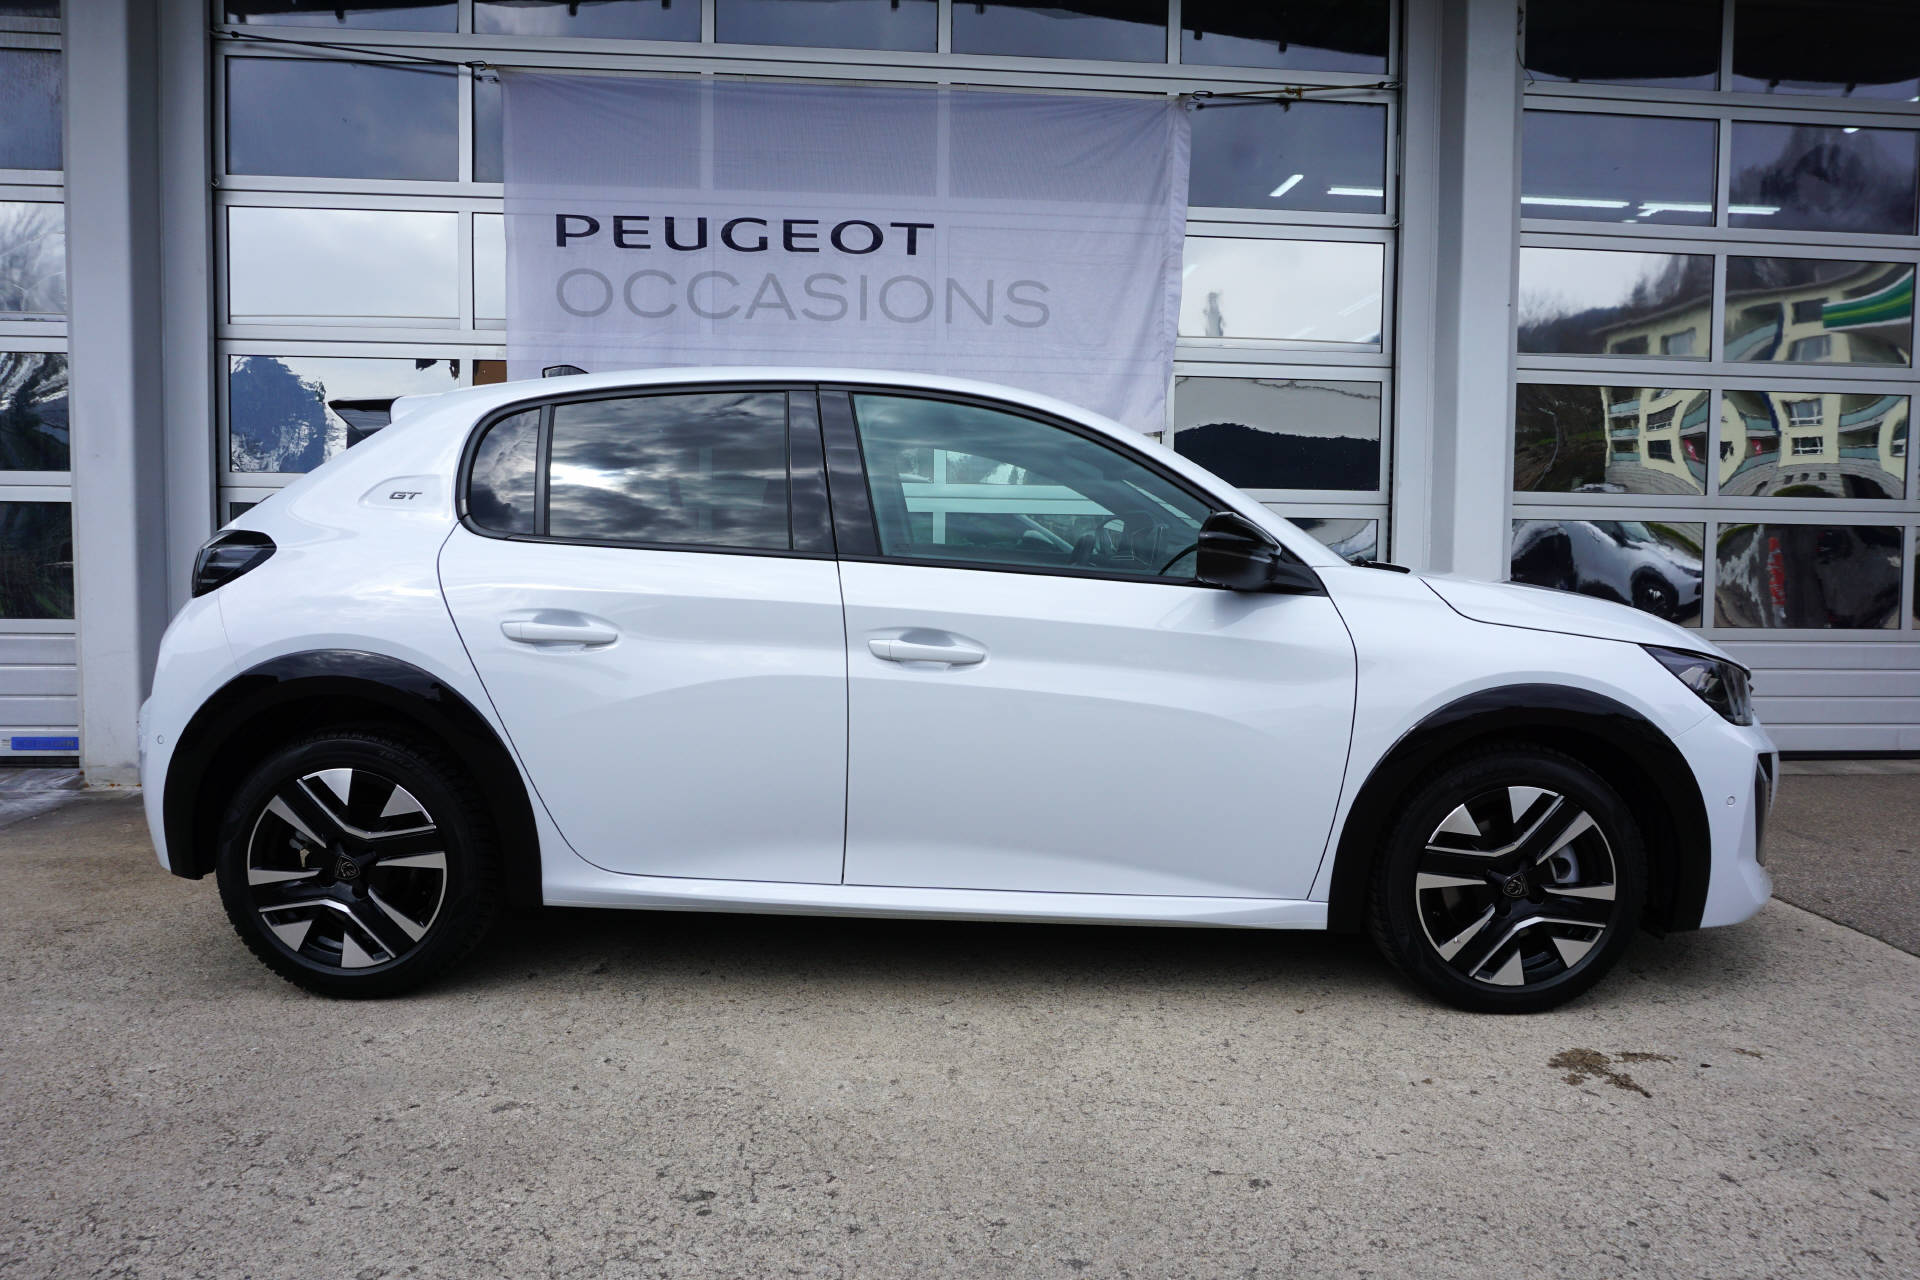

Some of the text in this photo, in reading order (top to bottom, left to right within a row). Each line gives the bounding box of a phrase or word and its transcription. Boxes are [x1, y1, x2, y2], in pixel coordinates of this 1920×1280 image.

[556, 214, 935, 256] PEUGEOT
[556, 268, 1051, 329] OCCASIONS
[389, 491, 423, 500] GT
